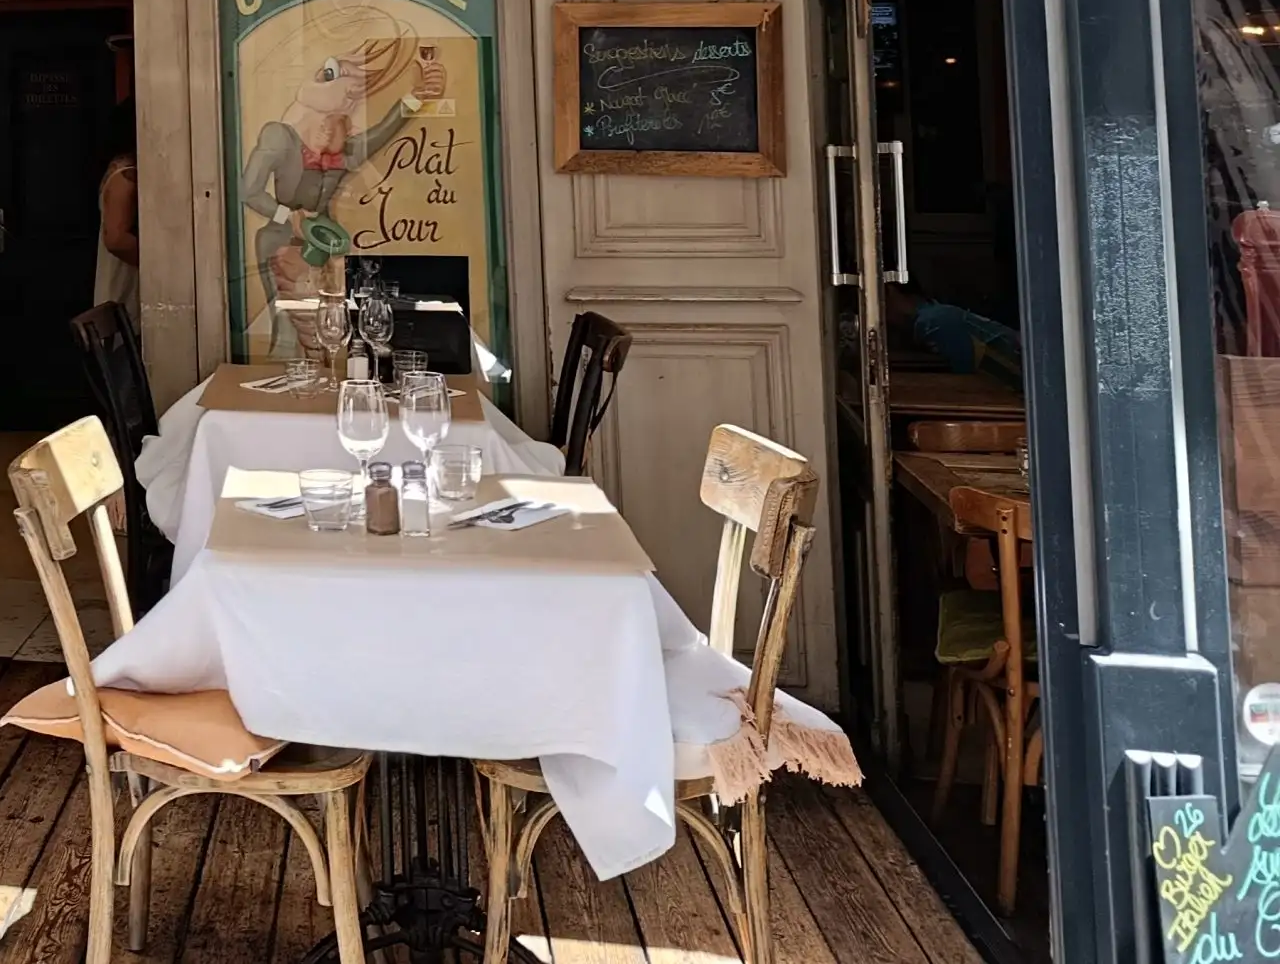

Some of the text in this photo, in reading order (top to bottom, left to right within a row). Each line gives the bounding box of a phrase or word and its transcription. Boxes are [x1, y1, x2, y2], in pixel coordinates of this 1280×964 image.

[381, 127, 474, 186] Plat
[352, 186, 444, 249] Jour
[427, 178, 457, 204] du
[1187, 911, 1244, 964] du
